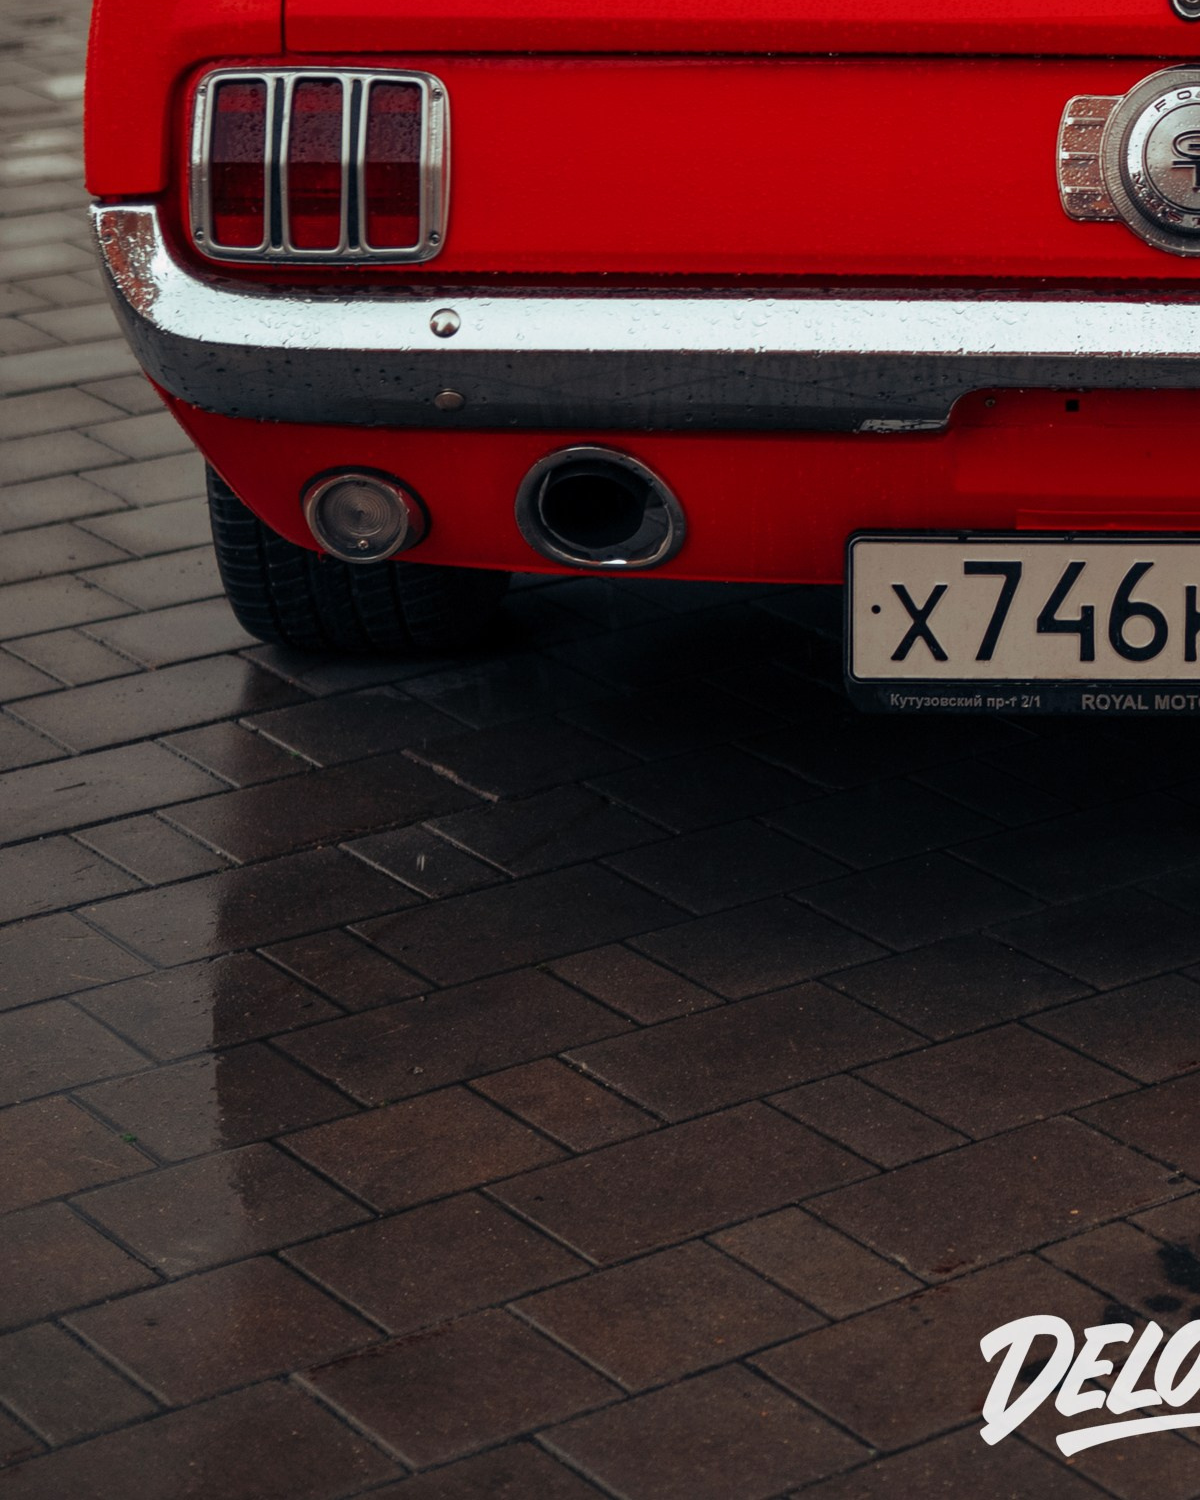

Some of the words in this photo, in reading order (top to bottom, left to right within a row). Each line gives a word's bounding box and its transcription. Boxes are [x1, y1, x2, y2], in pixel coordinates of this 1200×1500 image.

[890, 694, 982, 710] Кутузовский
[986, 695, 1016, 710] пр-т
[1021, 694, 1042, 708] 2/1
[1081, 694, 1149, 710] ROYAL
